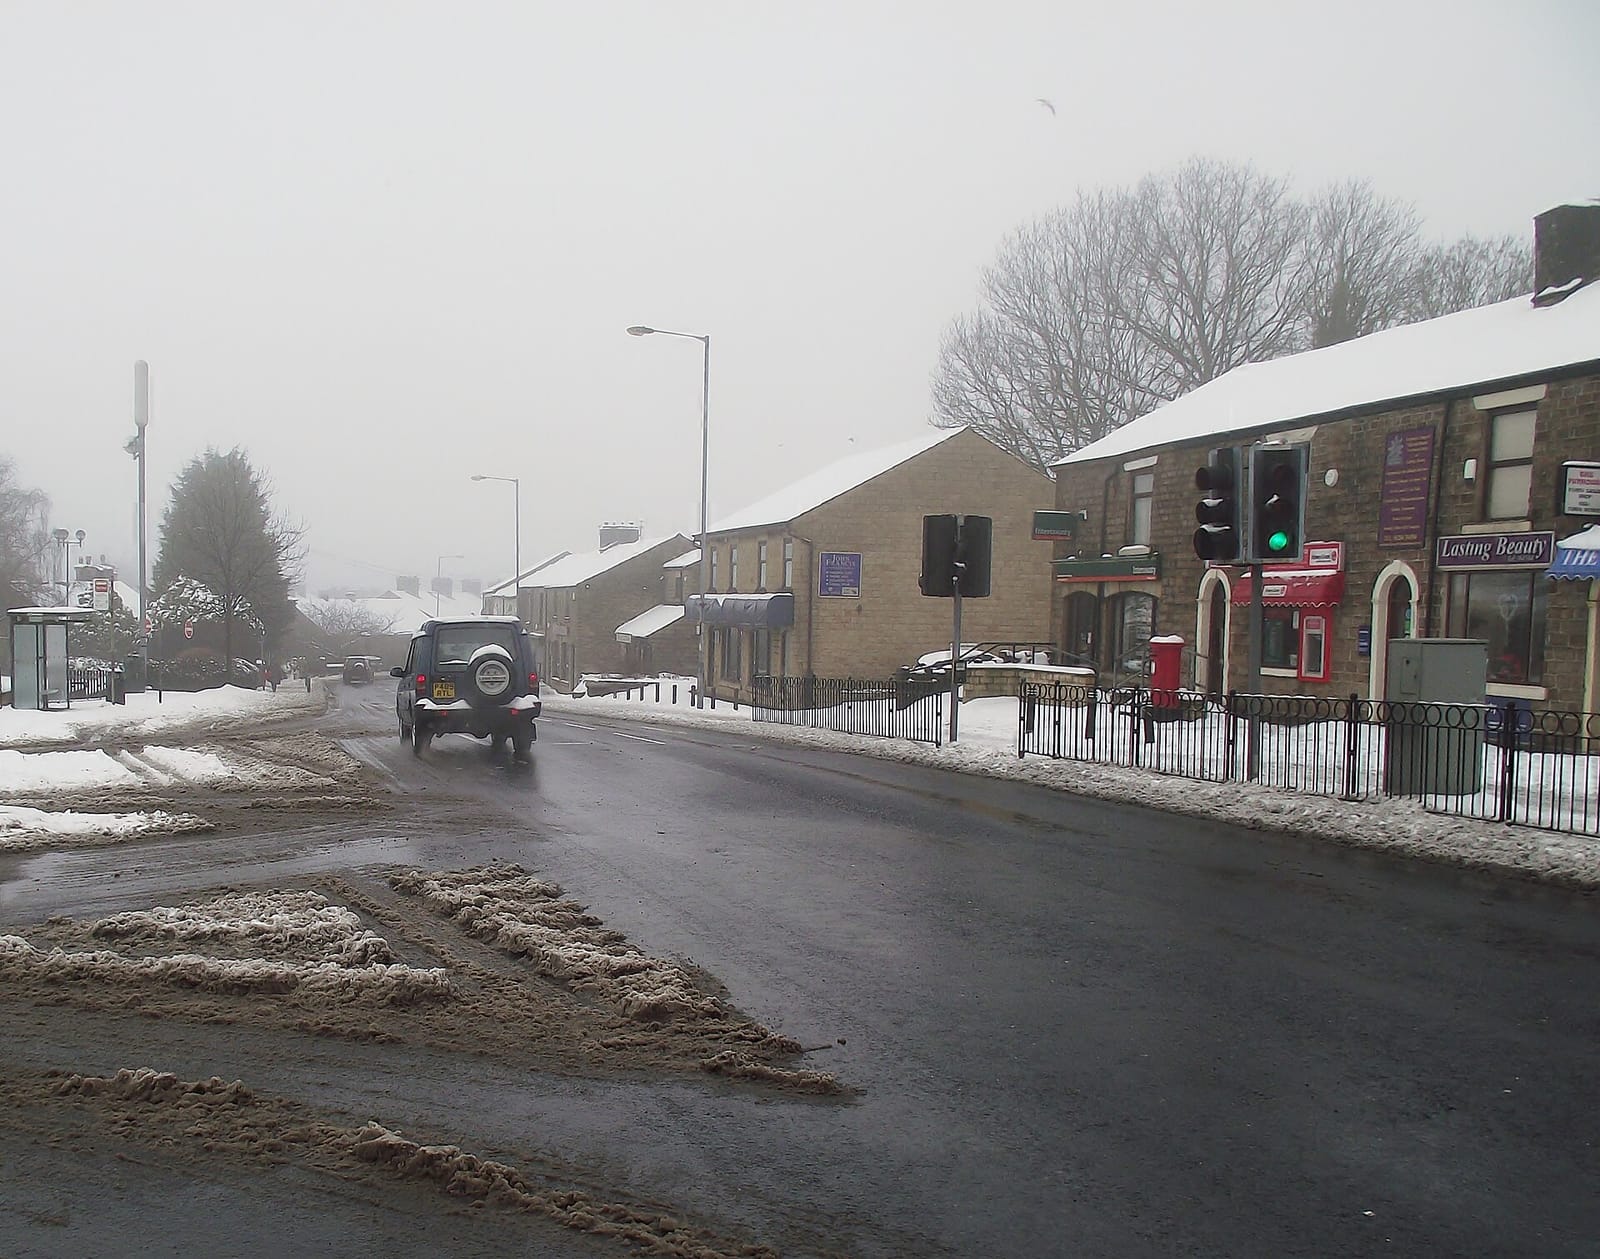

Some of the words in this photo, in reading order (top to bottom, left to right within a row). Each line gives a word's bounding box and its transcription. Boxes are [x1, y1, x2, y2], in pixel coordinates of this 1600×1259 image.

[1441, 540, 1492, 561] Lasting
[1496, 537, 1546, 559] Beauty
[1562, 549, 1598, 565] THE
